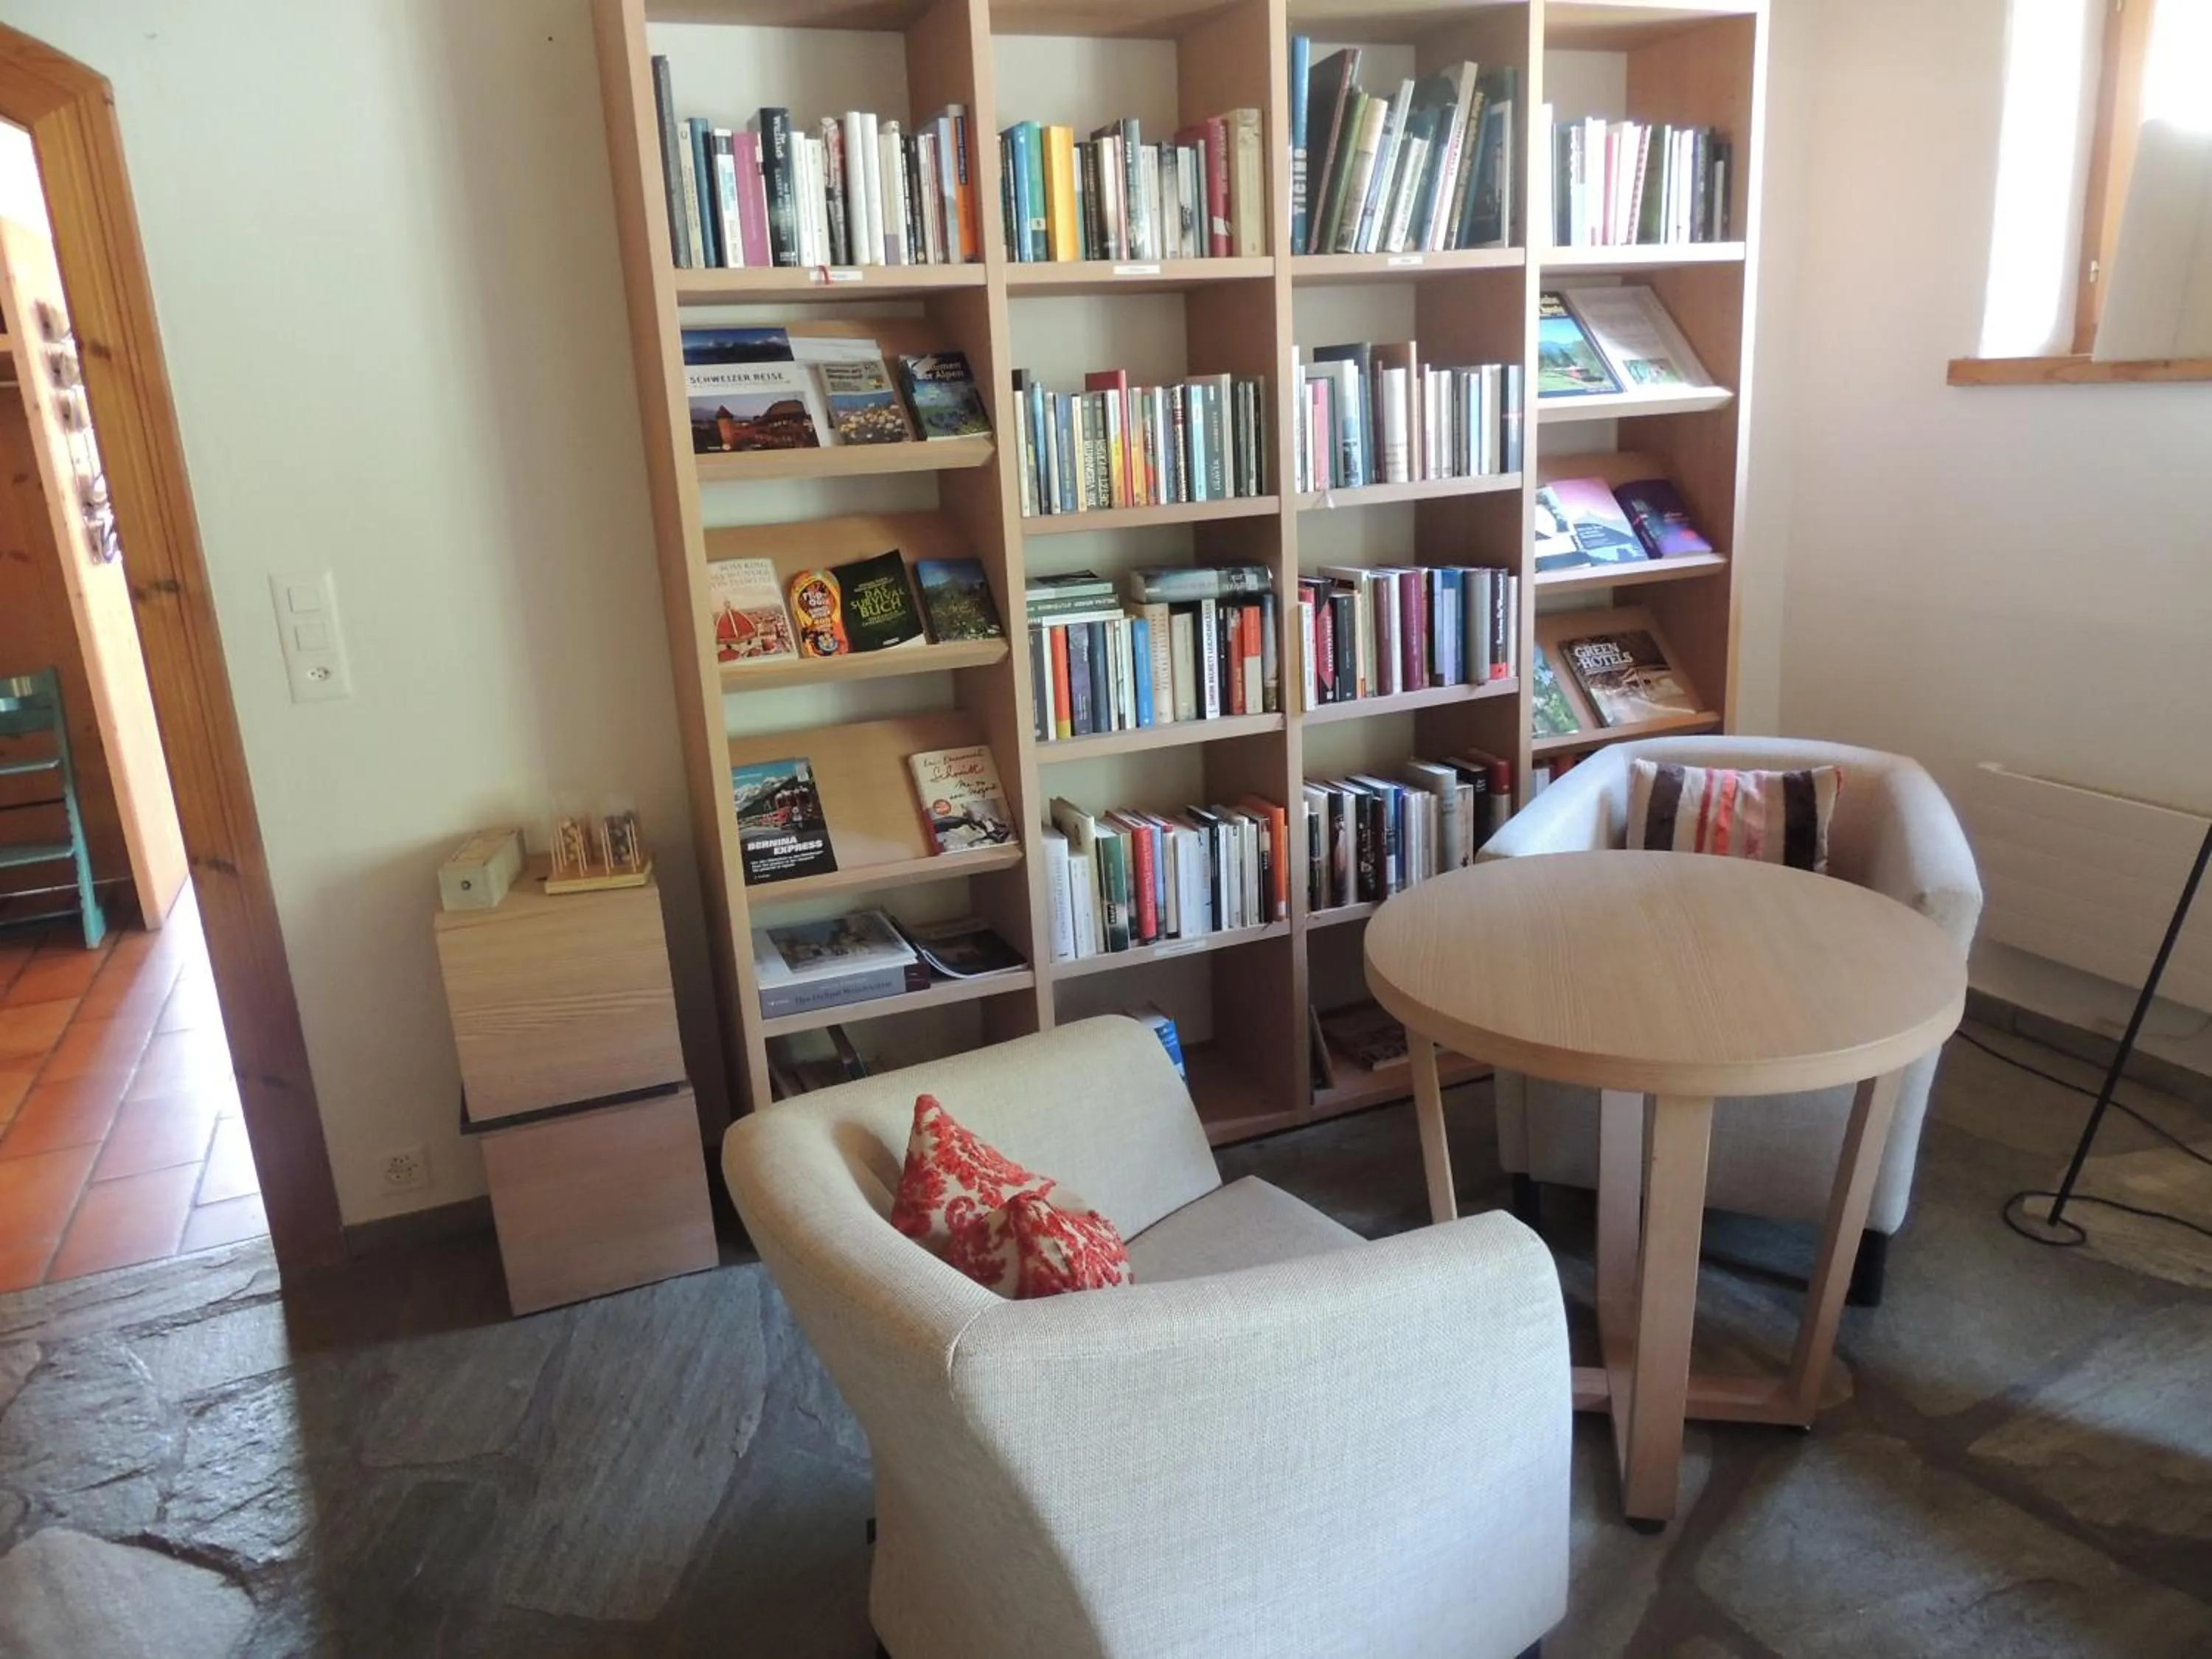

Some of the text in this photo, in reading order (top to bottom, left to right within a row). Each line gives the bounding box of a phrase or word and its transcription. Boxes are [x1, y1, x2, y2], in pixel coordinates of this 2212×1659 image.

[1293, 148, 1308, 215] TICINO
[689, 372, 785, 384] SCHWEIZER REISE
[860, 598, 902, 618] BUCH
[1574, 642, 1620, 658] GREEN
[1578, 651, 1633, 669] HOTELS
[747, 835, 798, 851] BERNINA
[773, 839, 824, 855] EXPRESS
